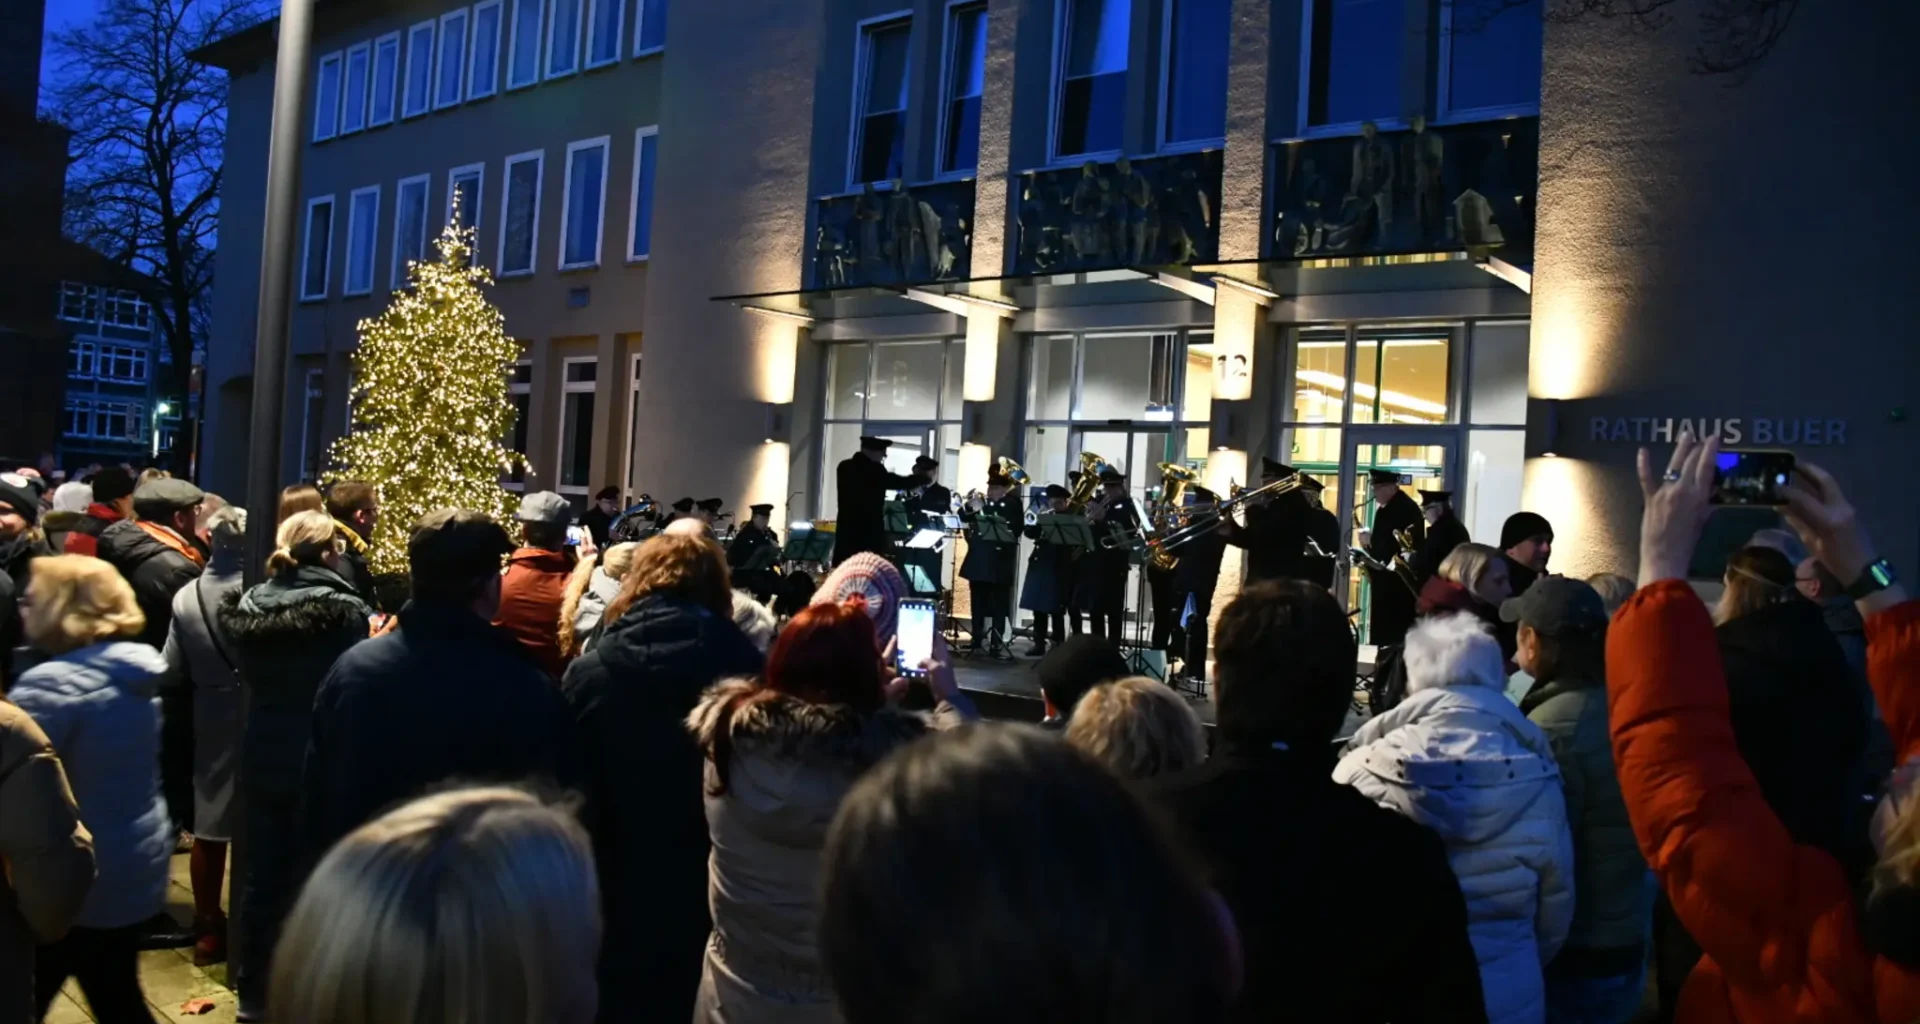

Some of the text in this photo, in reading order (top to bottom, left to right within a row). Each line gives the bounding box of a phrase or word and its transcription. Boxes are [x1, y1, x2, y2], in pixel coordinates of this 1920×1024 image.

[1217, 354, 1247, 380] 12
[1589, 416, 1847, 445] RATHAUS BUER
